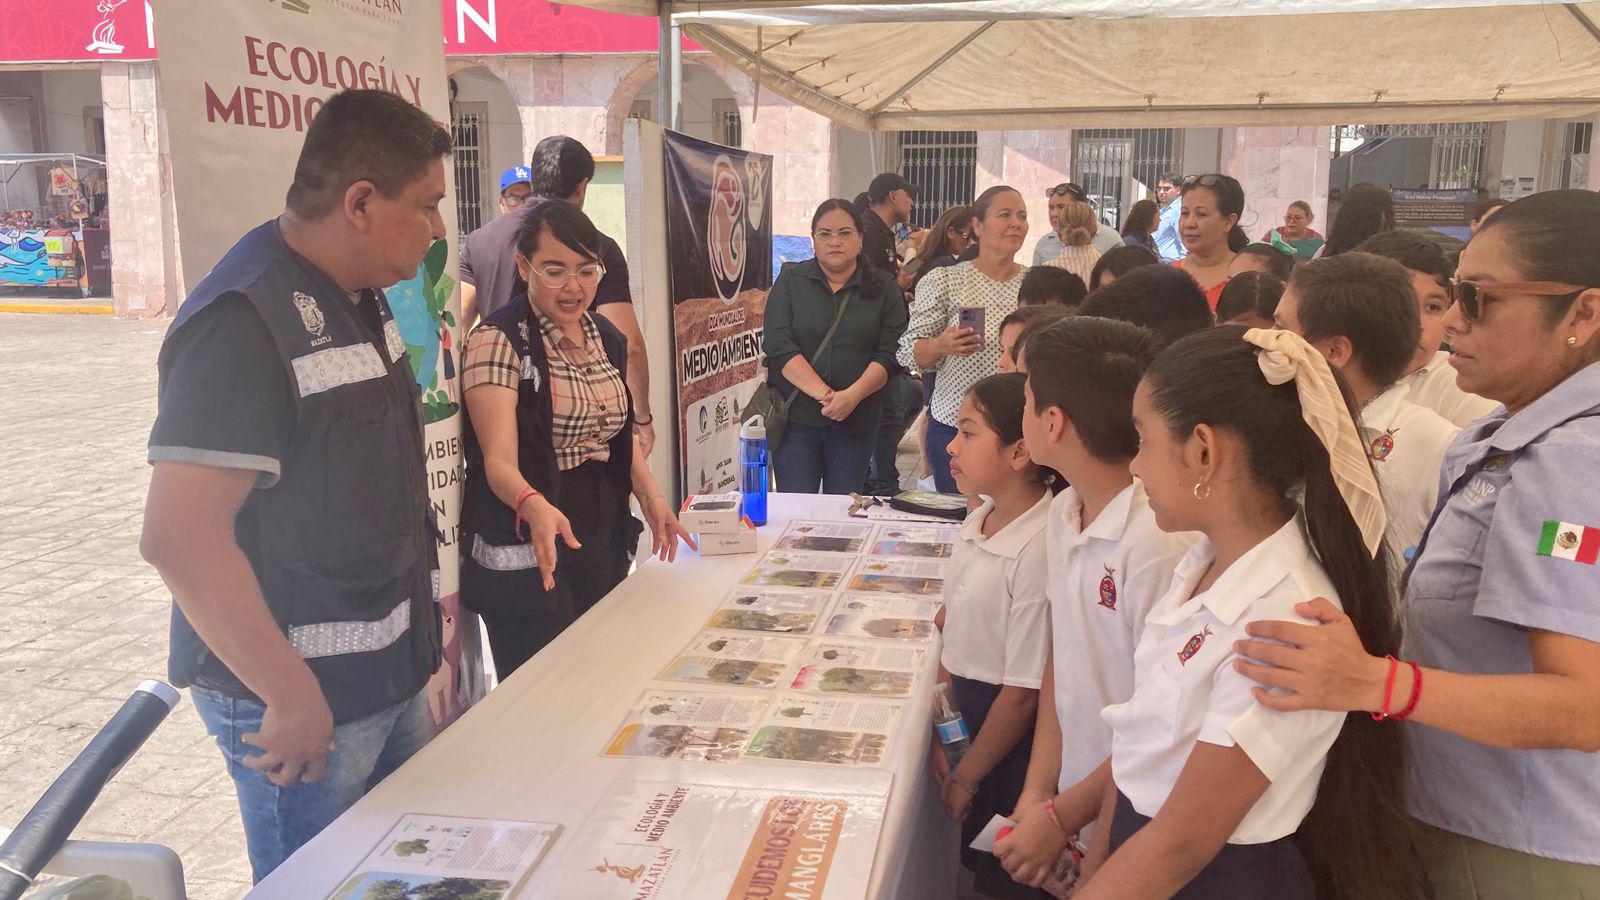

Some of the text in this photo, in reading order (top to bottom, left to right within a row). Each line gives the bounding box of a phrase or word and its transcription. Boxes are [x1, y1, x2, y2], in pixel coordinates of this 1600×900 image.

[245, 35, 421, 107] ECOLOGÍA Y
[683, 343, 719, 382] MEDIO
[645, 819, 670, 842] MEDIO
[660, 786, 690, 818] AMBIENTE
